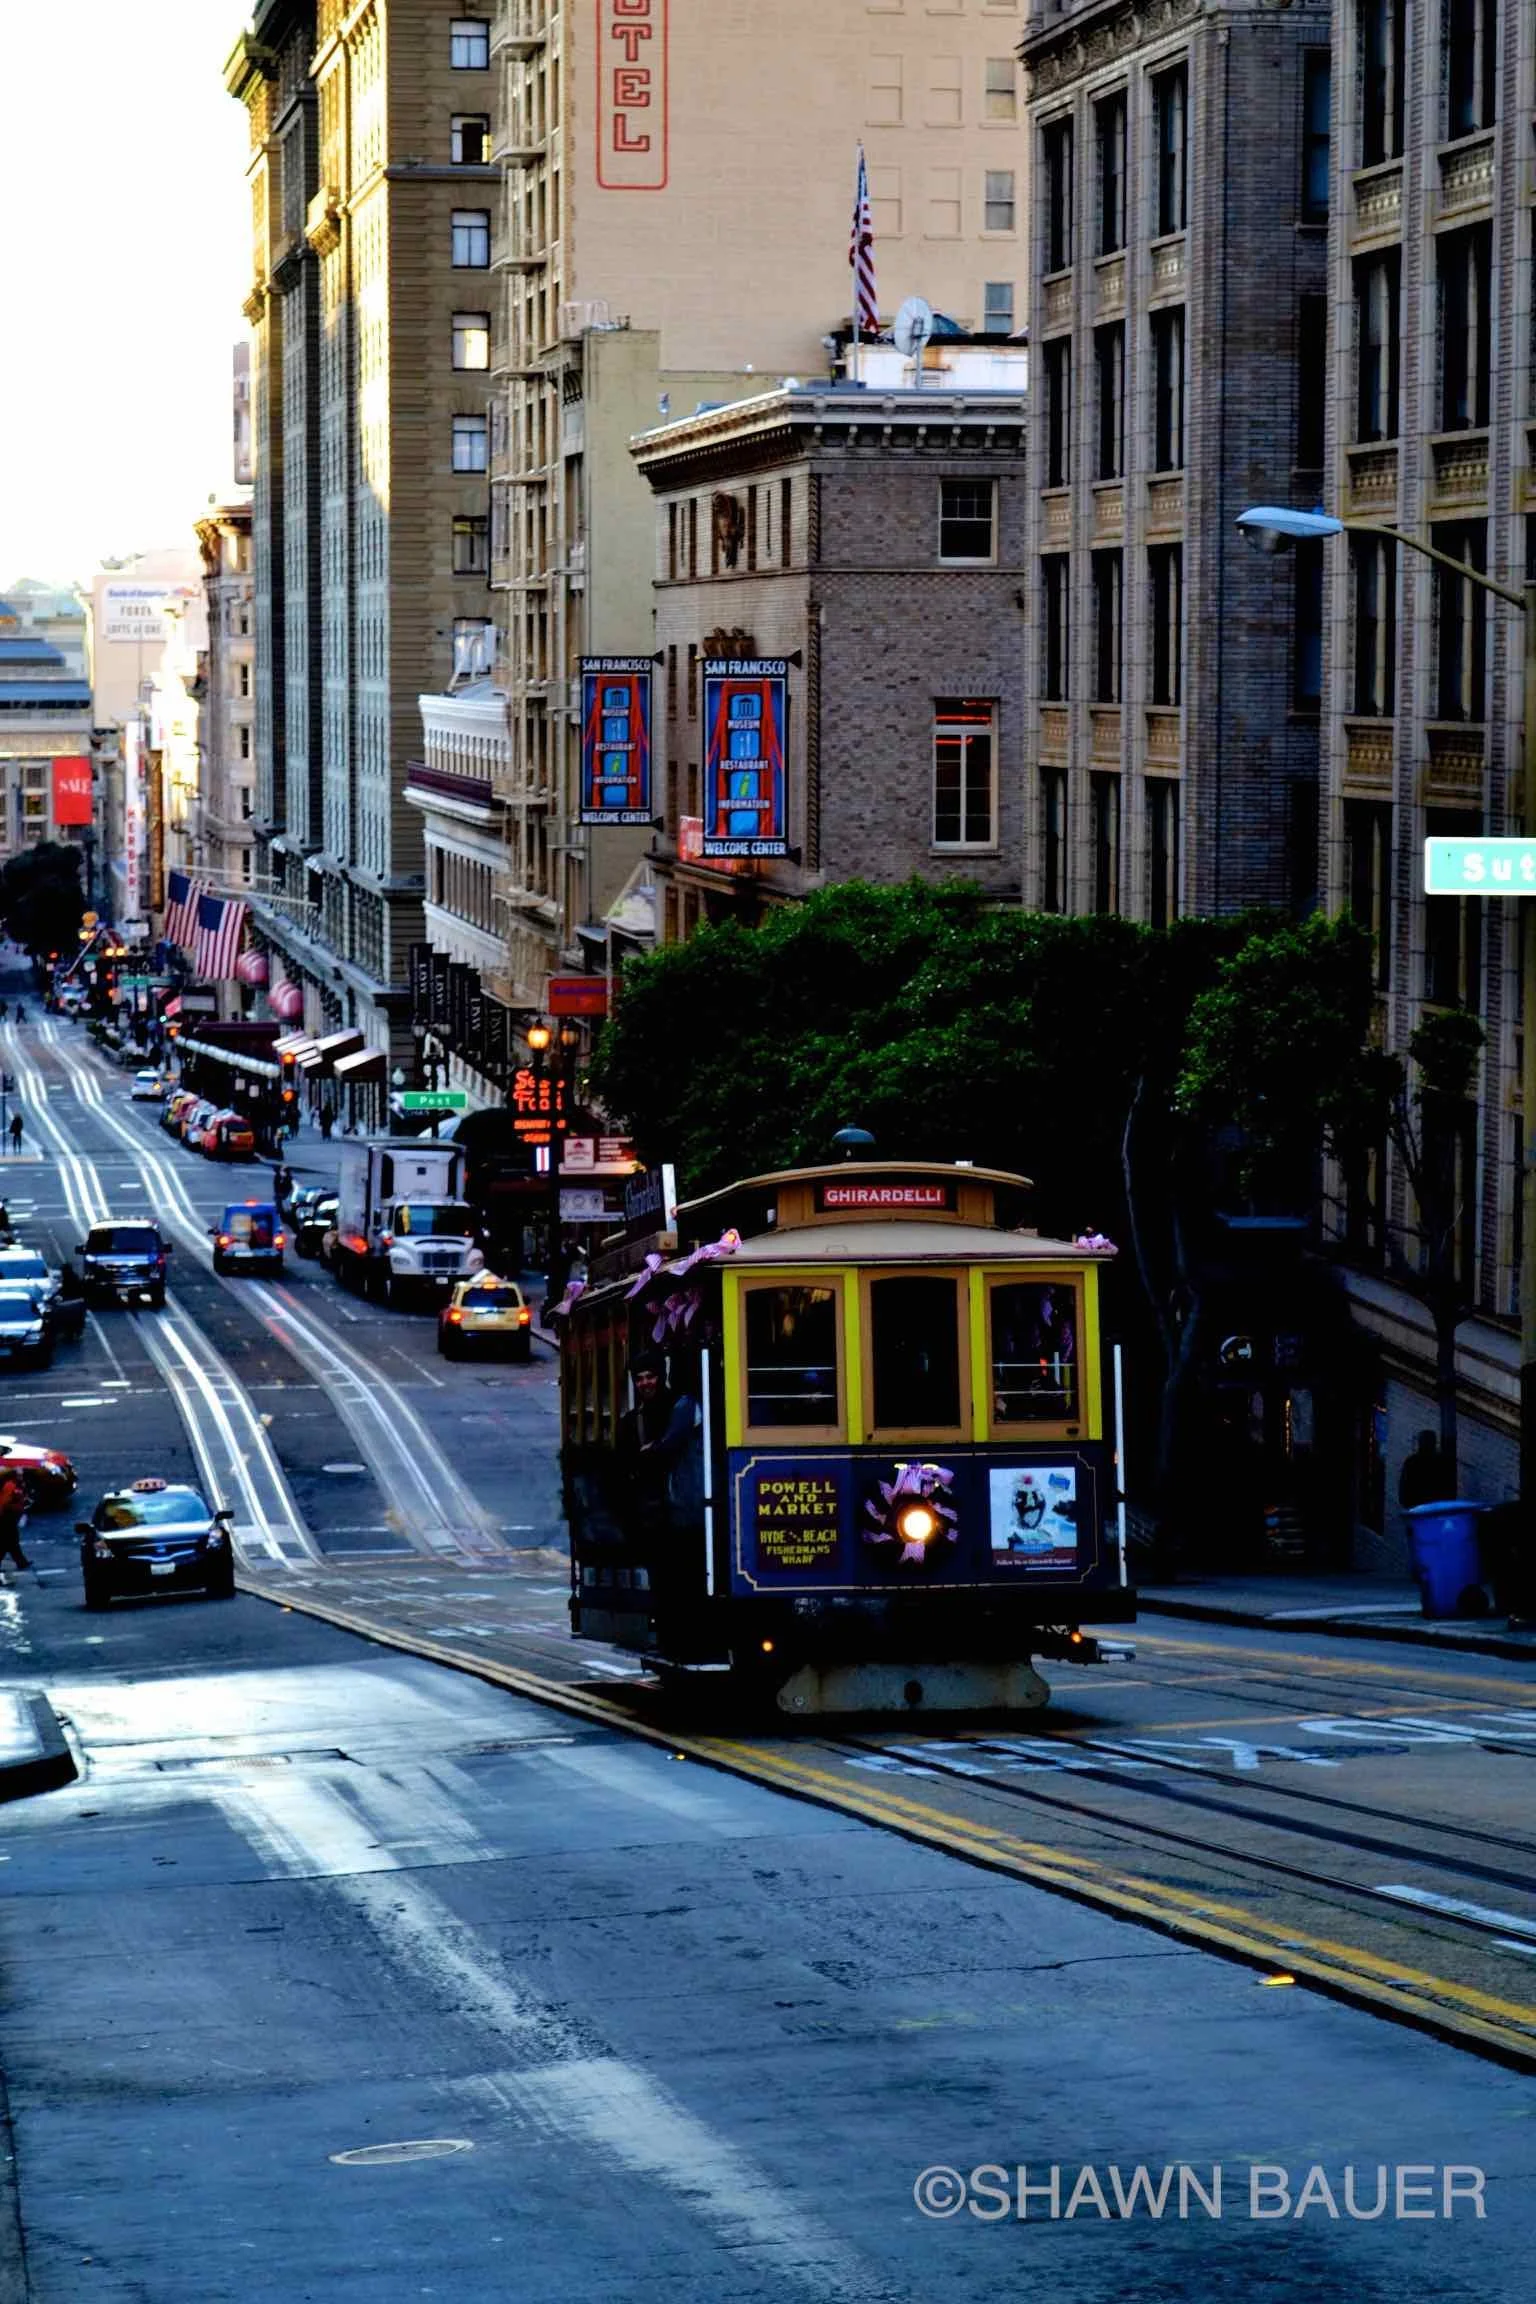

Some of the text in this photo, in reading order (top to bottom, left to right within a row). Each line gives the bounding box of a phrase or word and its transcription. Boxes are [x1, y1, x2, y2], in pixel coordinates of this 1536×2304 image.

[583, 659, 650, 671] SAN FRANCISCO
[705, 661, 786, 675] SAN FRANCISCO
[728, 719, 760, 729] MUSEUM
[720, 760, 769, 770] RESTAURANT
[718, 800, 770, 809] INFORMATION
[582, 812, 651, 824] WELCOME CENTER
[704, 842, 786, 855] WELCOME CENTER
[420, 1095, 451, 1105] Post
[826, 1189, 941, 1202] GHIRARDELLI
[760, 1482, 835, 1494] POWELL
[780, 1494, 817, 1503] AND
[759, 1503, 837, 1515] MARKET
[760, 1530, 786, 1543] HYDE
[803, 1529, 837, 1542] BEACH
[781, 1555, 814, 1564] WHARF
